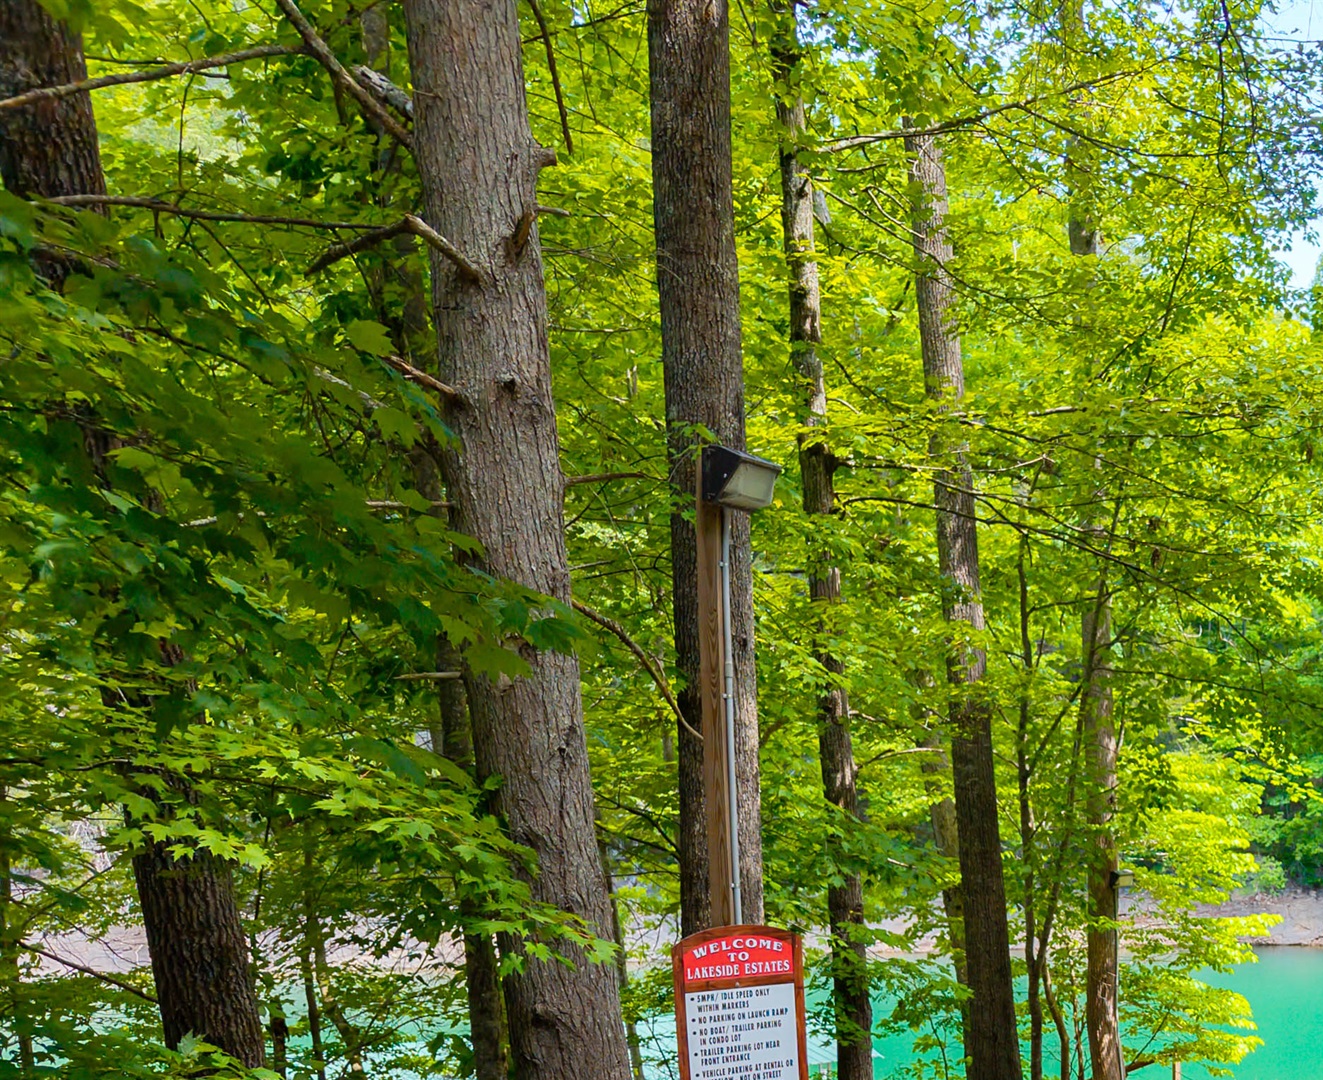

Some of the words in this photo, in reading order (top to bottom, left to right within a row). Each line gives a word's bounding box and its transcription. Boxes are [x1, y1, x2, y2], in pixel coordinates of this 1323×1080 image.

[692, 938, 783, 959] WELCOME
[727, 951, 750, 962] TO
[687, 964, 740, 980] LAKESIDE
[744, 959, 790, 975] ESTATES
[721, 992, 734, 1000] IDLE
[735, 990, 753, 999] SPEED
[755, 988, 770, 997] ONLY
[697, 1003, 720, 1013] WITHIN
[721, 1000, 750, 1010] MARKERS
[698, 1016, 707, 1024] NO
[709, 1013, 735, 1023] PARKING
[737, 1012, 746, 1020] ON
[747, 1009, 770, 1018] LAUNCH
[771, 1007, 788, 1016] RAMP
[699, 1028, 708, 1036] NO
[731, 1023, 755, 1033] TRAILER
[756, 1020, 782, 1030] PARKING
[699, 1038, 707, 1046] IN
[708, 1035, 730, 1045] CONDO
[731, 1033, 741, 1042] LOT
[700, 1047, 724, 1057] TRAILER
[726, 1044, 752, 1054] PARKING
[753, 1042, 764, 1051] LOT
[765, 1040, 780, 1049] NEAR
[701, 1057, 720, 1066] FRONT
[722, 1053, 751, 1064] ENTRANCE
[702, 1068, 726, 1078] VEHICLE
[727, 1064, 753, 1075] PARKING
[755, 1063, 762, 1071] AT
[764, 1060, 784, 1070] RENTAL
[785, 1059, 793, 1067] OR
[753, 1073, 761, 1080] ON
[762, 1070, 782, 1080] STREET
